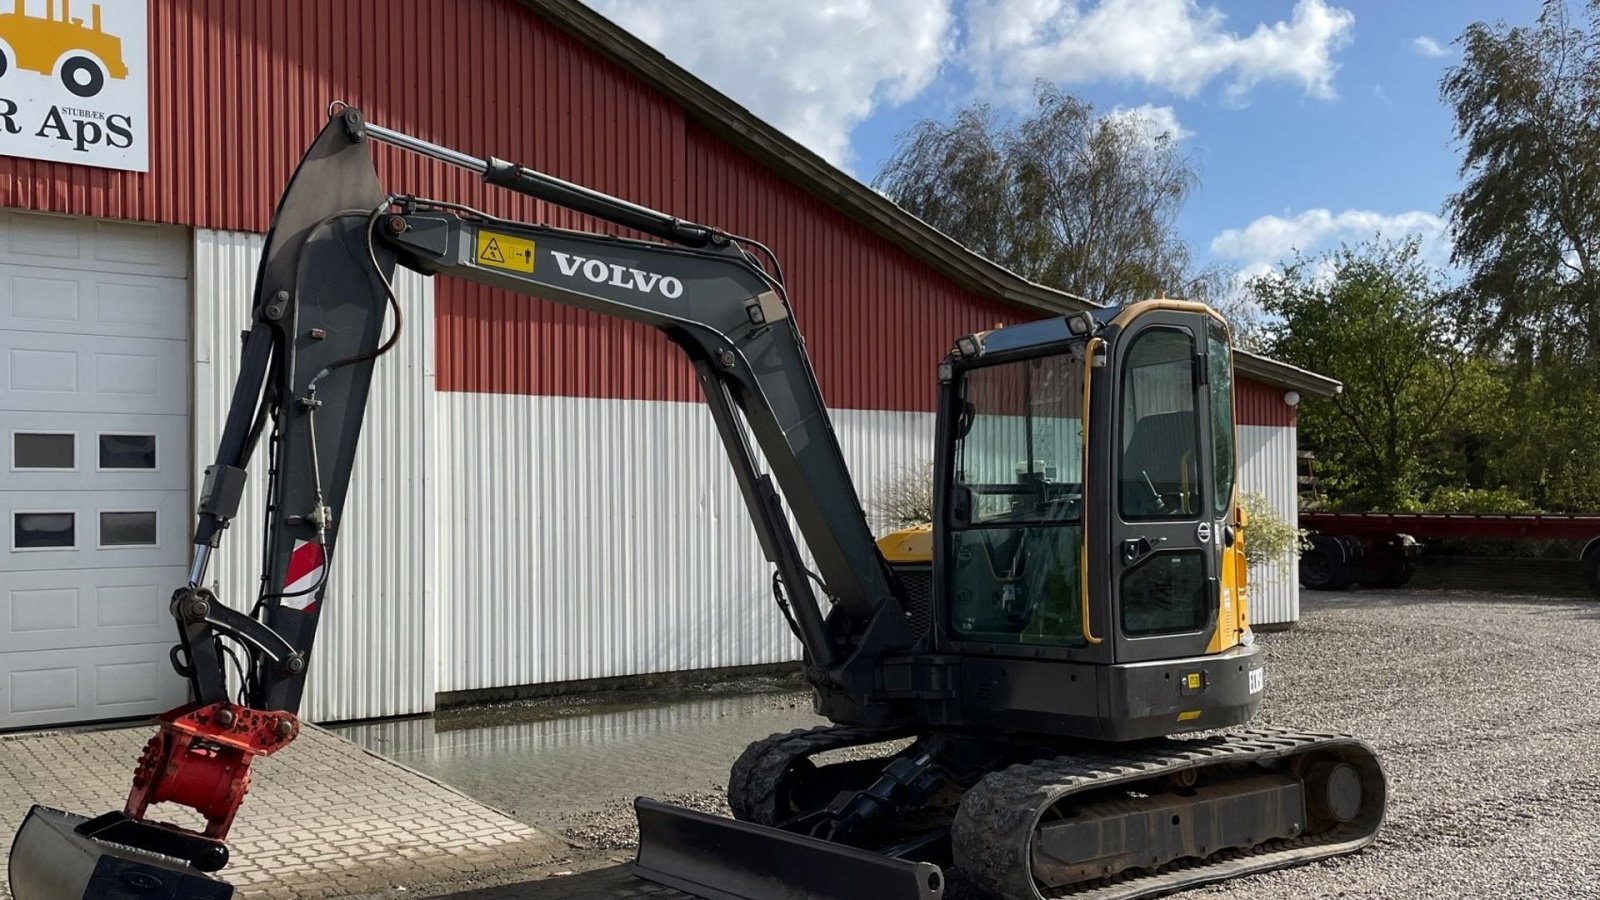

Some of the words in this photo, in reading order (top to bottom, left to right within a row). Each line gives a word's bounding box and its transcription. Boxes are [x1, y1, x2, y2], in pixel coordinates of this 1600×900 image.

[35, 105, 133, 152] ApS
[61, 106, 105, 120] STUBBÆK
[551, 251, 684, 299] VOLVO
